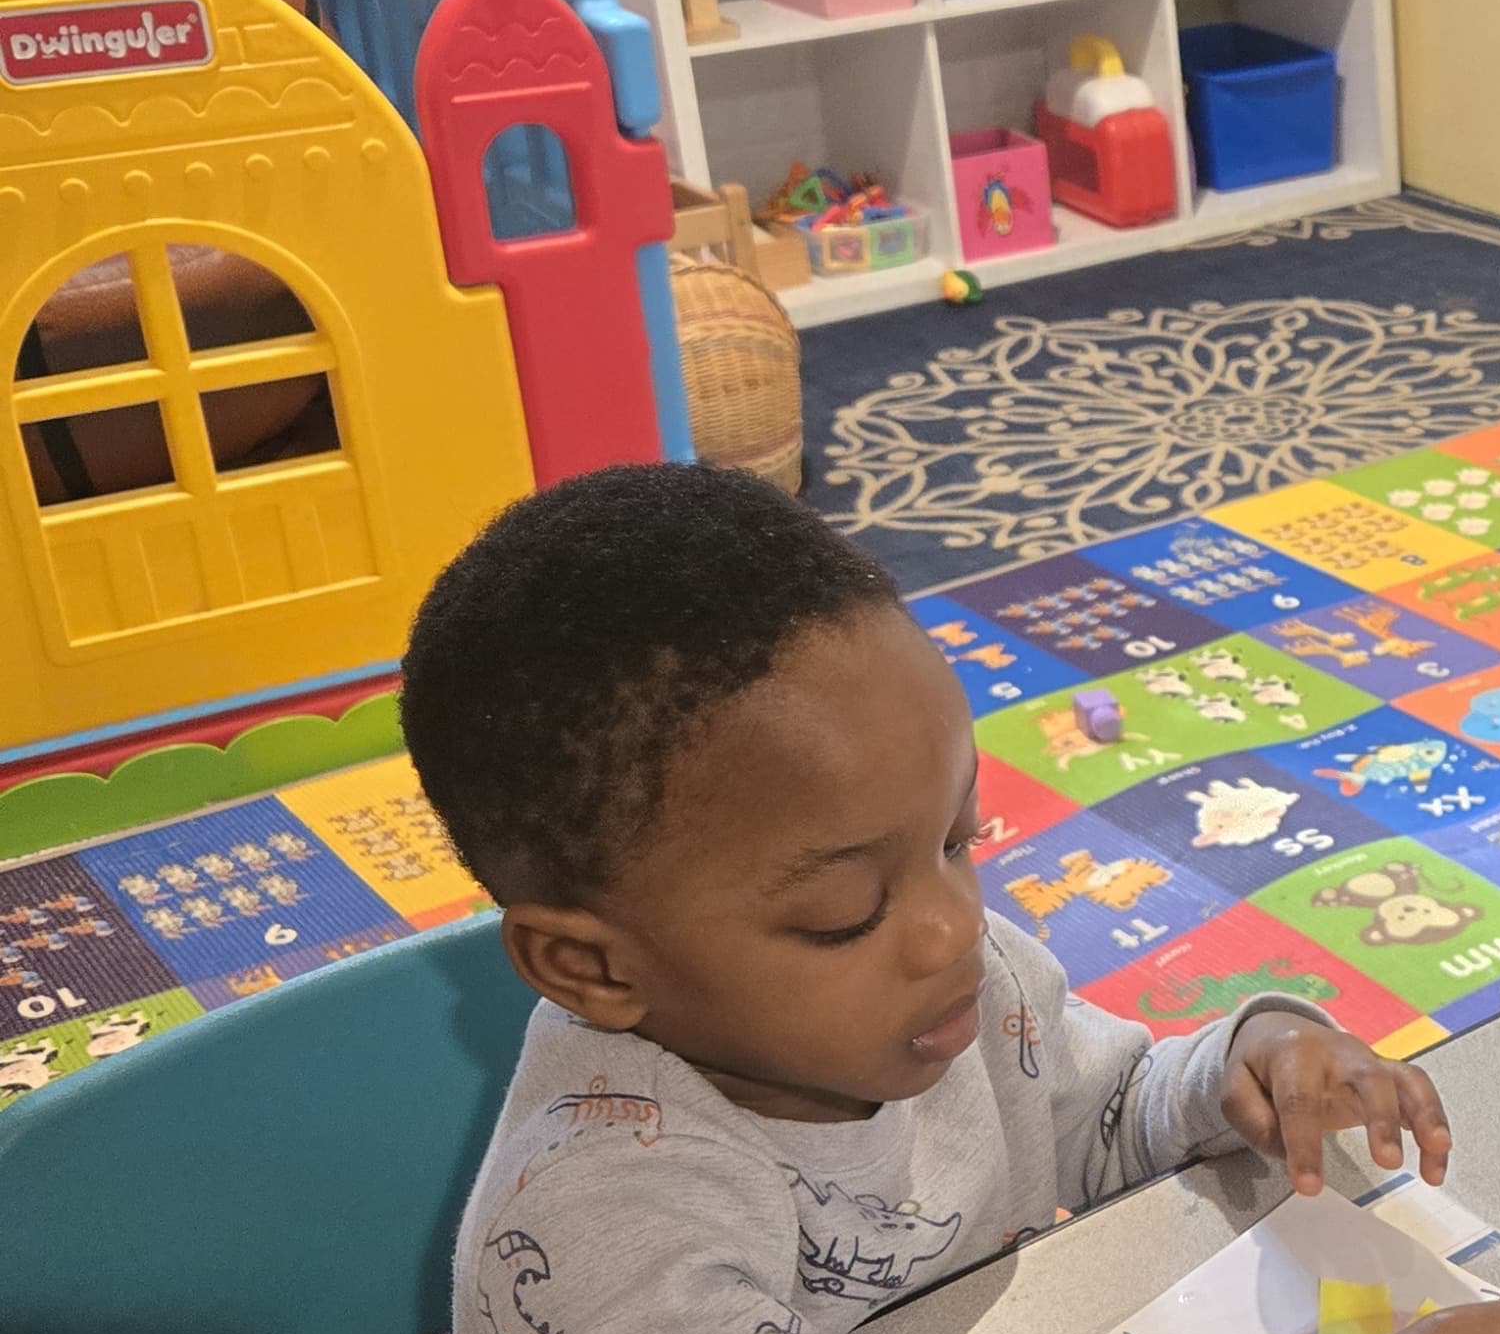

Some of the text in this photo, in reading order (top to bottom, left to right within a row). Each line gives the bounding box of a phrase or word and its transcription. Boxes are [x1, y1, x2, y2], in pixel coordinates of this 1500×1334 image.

[1417, 785, 1486, 817] Xx
[1272, 828, 1335, 856] Ss
[1111, 918, 1170, 950] Tt
[17, 987, 88, 1020] 10
